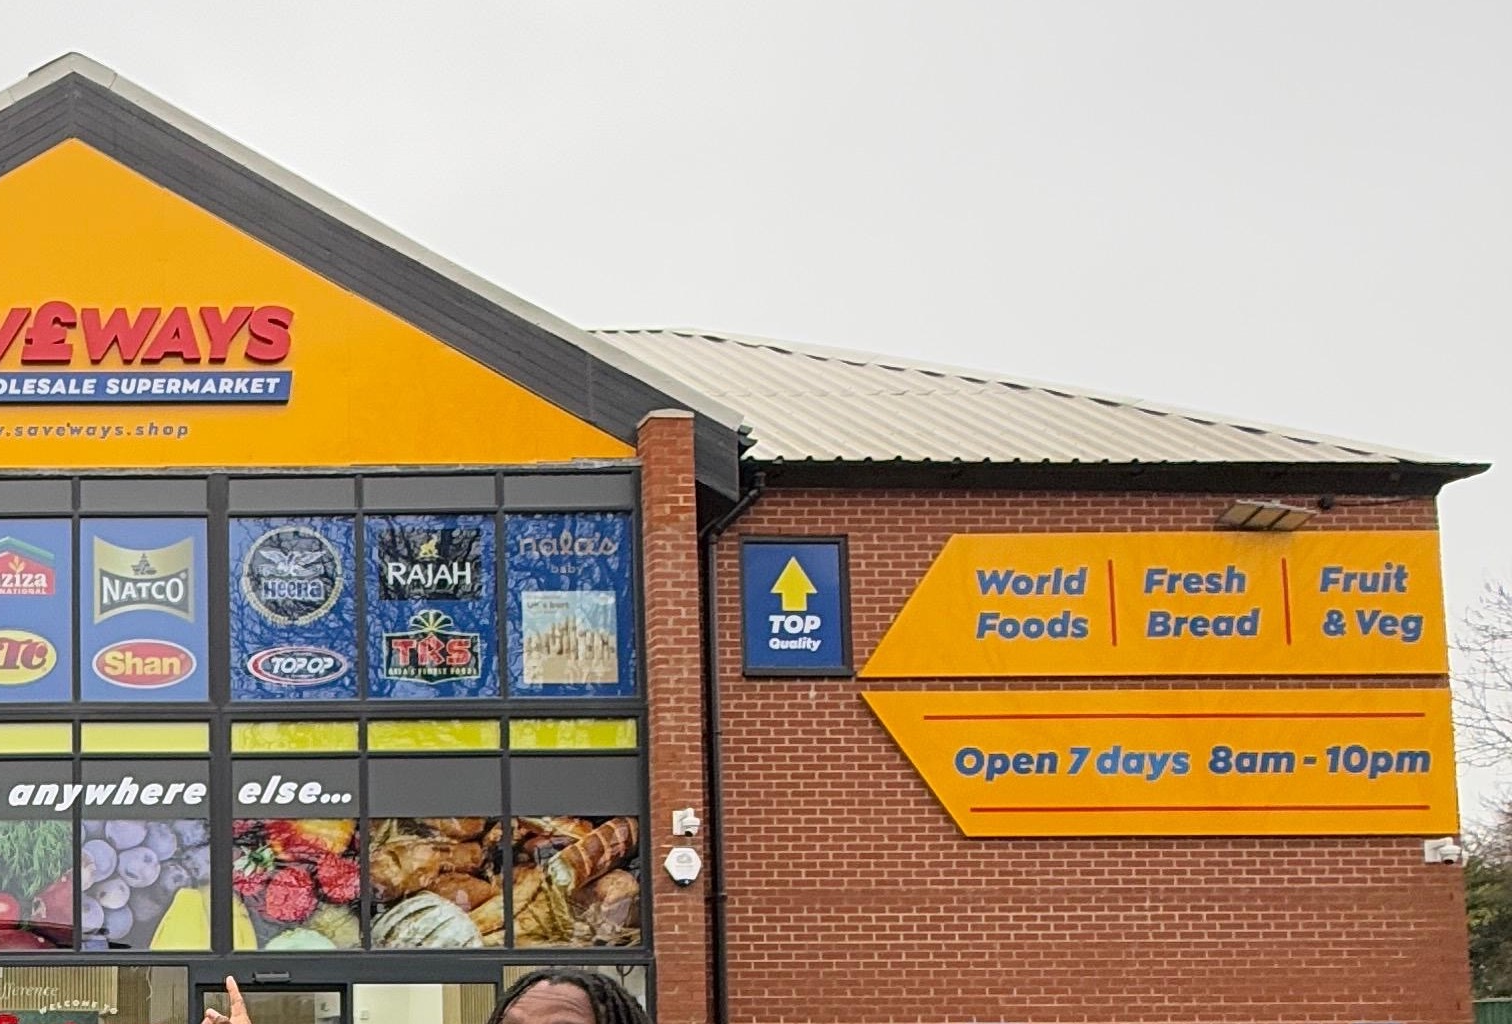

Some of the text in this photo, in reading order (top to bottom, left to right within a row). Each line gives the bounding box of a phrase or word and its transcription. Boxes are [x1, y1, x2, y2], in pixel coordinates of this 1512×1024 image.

[105, 378, 281, 396] SUPERMARKET
[387, 562, 471, 588] RAJAH
[976, 567, 1088, 595] World
[1143, 565, 1246, 594] Fresh
[1319, 562, 1409, 593] Fruit
[102, 577, 184, 604] NATCO
[769, 615, 821, 634] TOP
[976, 610, 1089, 639] Foods
[1147, 608, 1261, 637] Bread
[1323, 609, 1423, 643] & Veg
[392, 634, 472, 667] TRS
[768, 636, 822, 652] Quality
[104, 651, 181, 676] Shan
[954, 748, 1057, 781] Open
[1066, 748, 1091, 775] 7
[1096, 746, 1191, 781] days
[1208, 747, 1296, 774] 8am
[1325, 746, 1431, 779] 10pm
[8, 778, 207, 812] anywhere
[238, 776, 353, 805] else...
